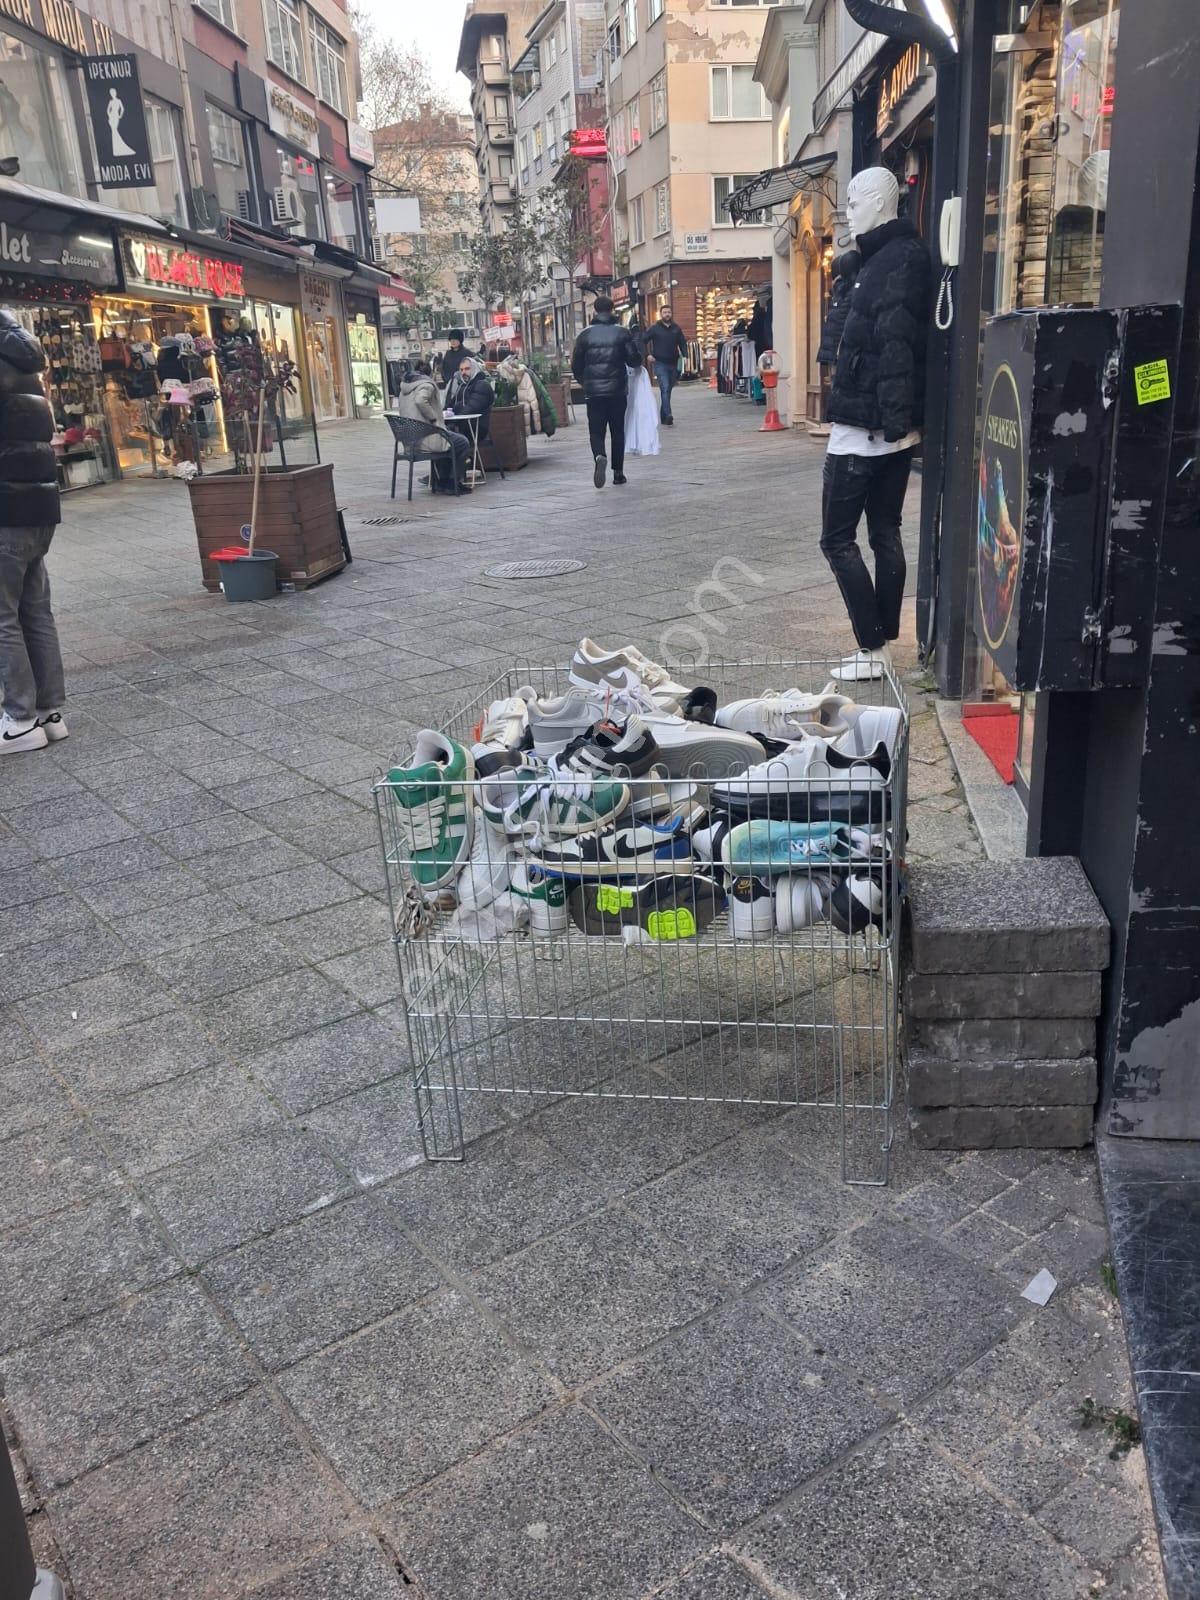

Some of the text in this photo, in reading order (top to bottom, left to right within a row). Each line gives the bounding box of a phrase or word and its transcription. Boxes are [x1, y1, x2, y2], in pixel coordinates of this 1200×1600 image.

[101, 164, 131, 182] MODA
[0, 221, 32, 264] let
[987, 415, 1018, 449] SNEAKERS
